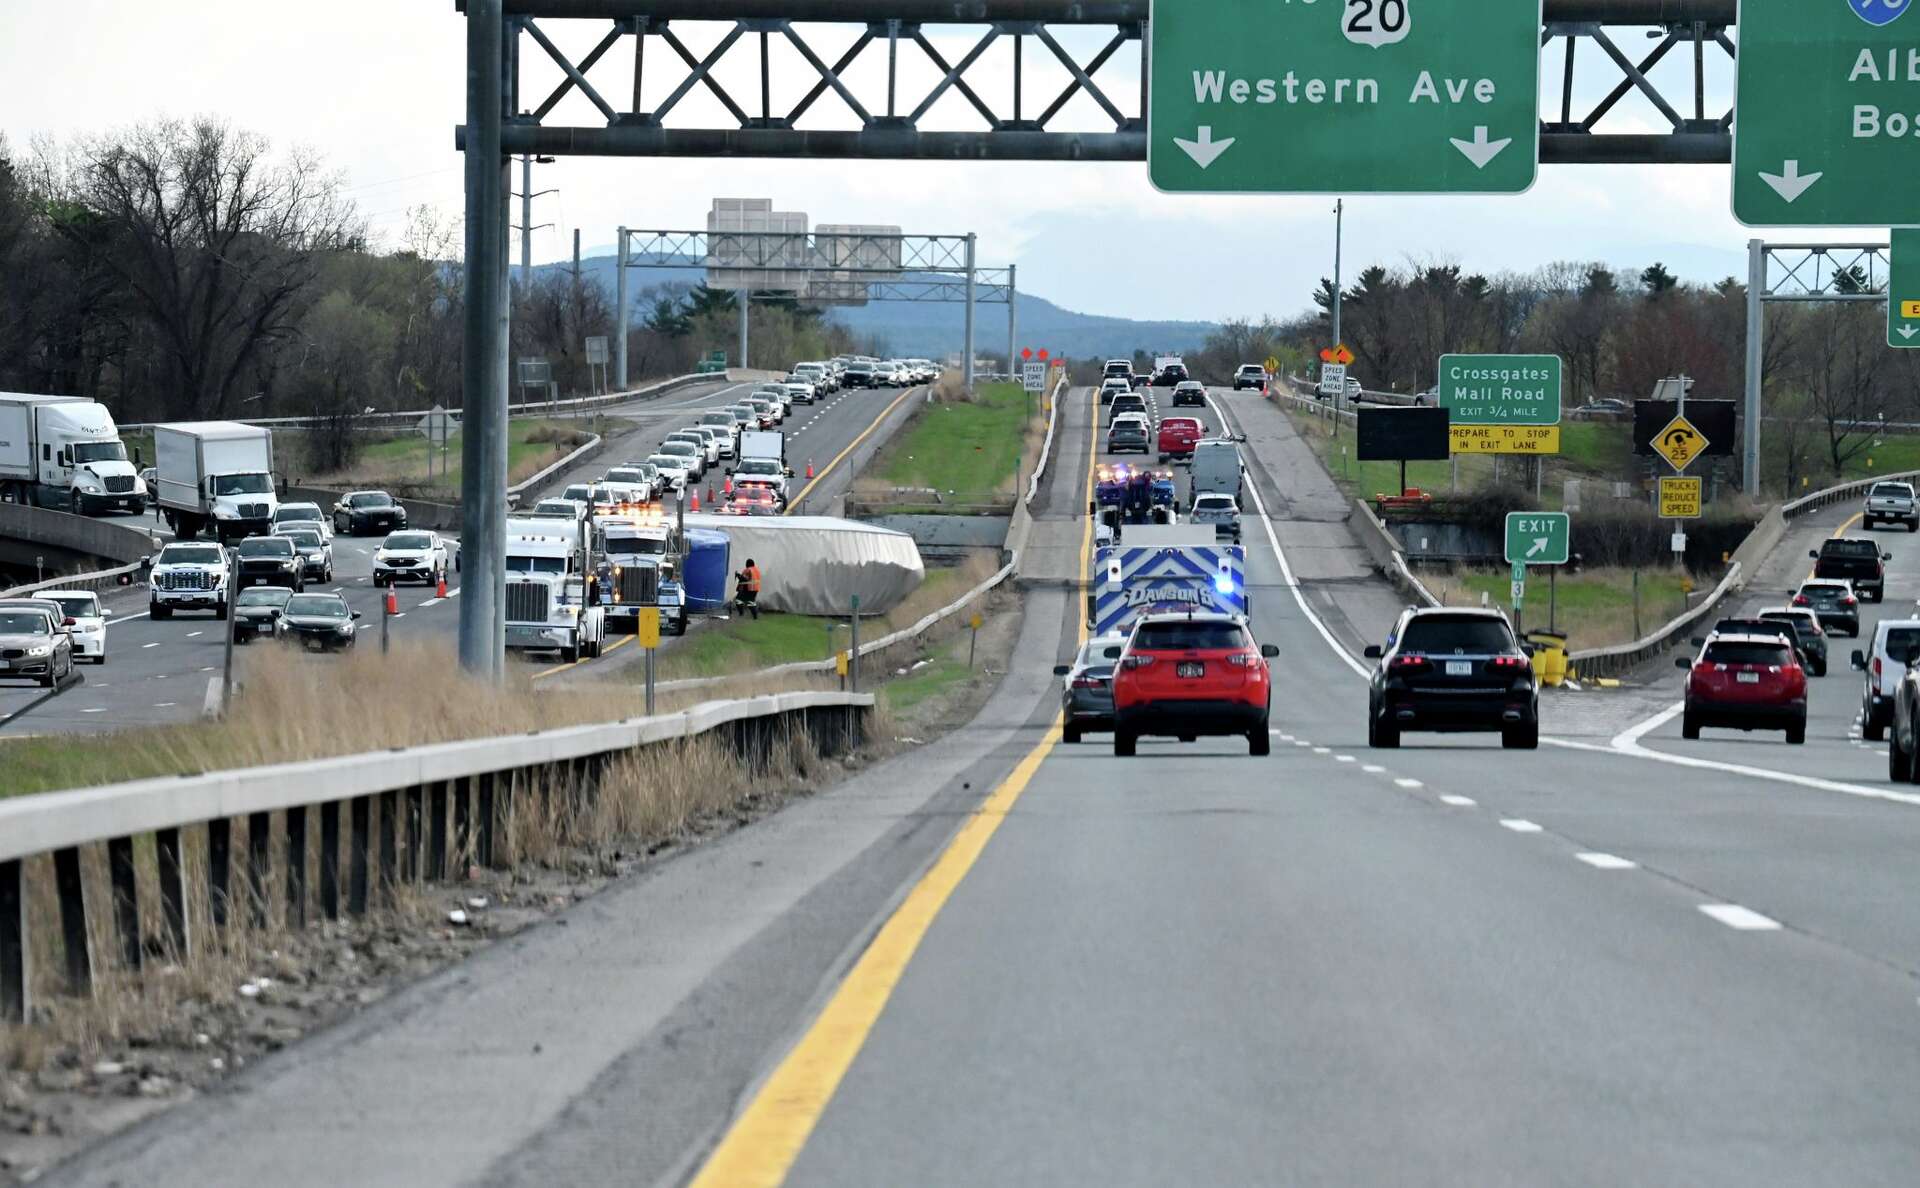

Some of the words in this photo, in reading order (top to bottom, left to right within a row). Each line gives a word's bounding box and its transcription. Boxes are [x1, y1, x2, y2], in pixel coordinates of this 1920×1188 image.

[1347, 0, 1405, 33] 20
[1192, 70, 1379, 104] Western
[1408, 70, 1496, 104] Ave
[1450, 367, 1549, 384] Crossgates
[1455, 387, 1491, 400] Mall
[1502, 388, 1544, 400] Road
[1459, 407, 1483, 417] EXIT
[1489, 406, 1507, 418] 3/4
[1513, 407, 1538, 417] MILE
[1502, 429, 1515, 438] TO
[1527, 429, 1551, 438] STOP
[1459, 440, 1469, 449] IN
[1480, 440, 1501, 449] EXIT
[1512, 440, 1538, 449] LANE
[1671, 449, 1688, 460] 25
[1663, 481, 1697, 491] TRUCKS
[1663, 493, 1697, 501] REDUCE
[1666, 504, 1694, 513] SPEED
[1518, 520, 1555, 532] EXIT
[1514, 583, 1521, 596] 3
